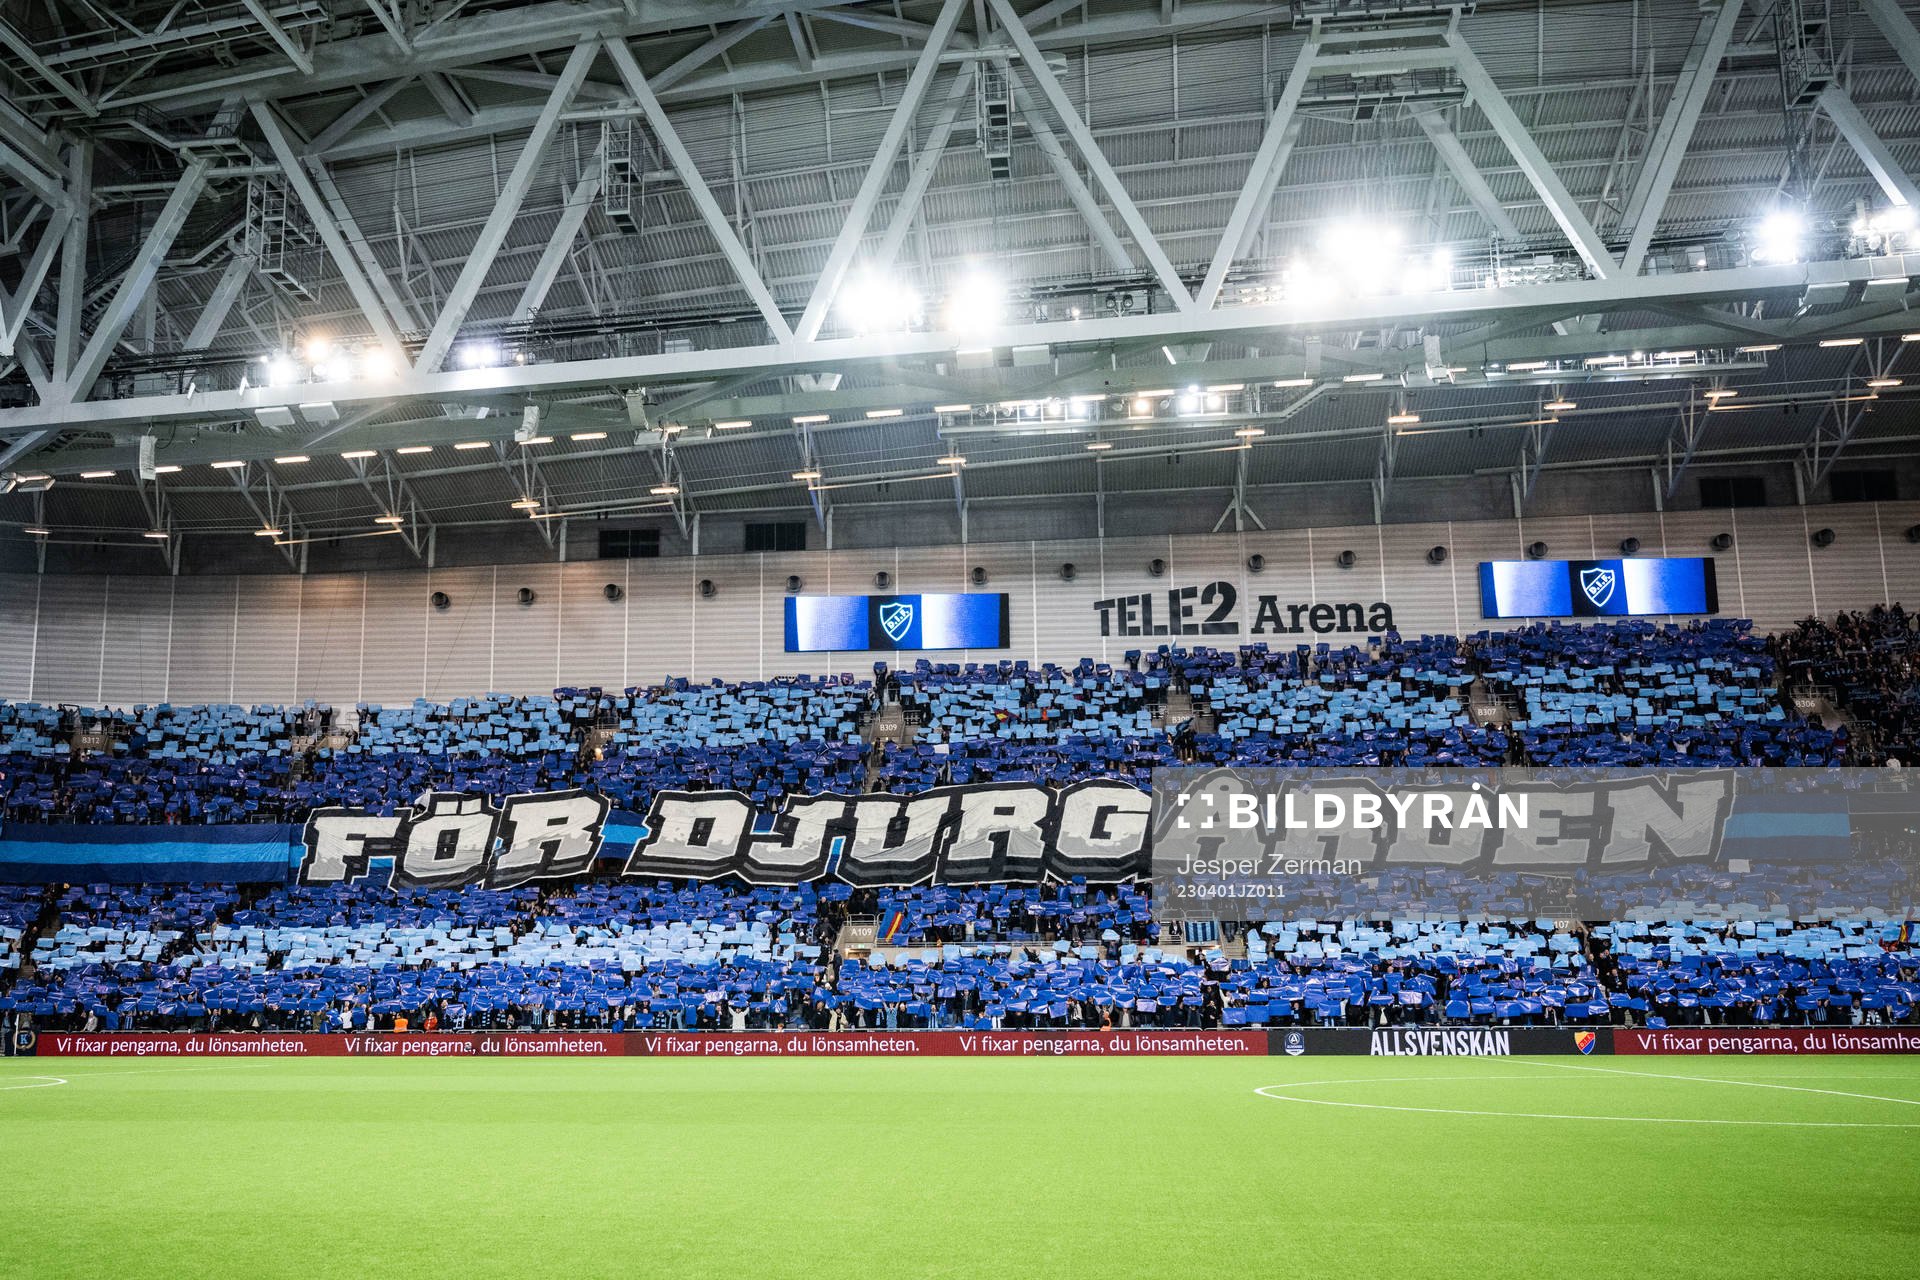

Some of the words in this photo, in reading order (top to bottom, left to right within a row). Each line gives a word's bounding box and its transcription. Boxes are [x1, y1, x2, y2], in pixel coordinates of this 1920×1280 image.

[1094, 581, 1239, 636] TELE2
[1250, 595, 1397, 634] Arena
[299, 791, 608, 886] FÖR
[851, 928, 872, 936] A109
[56, 1037, 72, 1052] Vi
[75, 1037, 107, 1052] fixar
[111, 1041, 182, 1055] pengarna,
[185, 1037, 205, 1052] du
[208, 1037, 308, 1053] lönsamheten.
[344, 1037, 361, 1052] Vi
[364, 1037, 398, 1052] fixar
[480, 1037, 500, 1052] du
[504, 1037, 608, 1053] lönsamheten.
[644, 1036, 662, 1052] Vi
[665, 1036, 702, 1052] fixar
[705, 1041, 783, 1055] pengarna,
[787, 1036, 807, 1052] du
[812, 1036, 920, 1052] lönsamheten.
[959, 1036, 977, 1052] Vi
[981, 1036, 1019, 1052] fixar
[1023, 1040, 1105, 1055] pengarna,
[1109, 1035, 1131, 1052] du
[1135, 1035, 1249, 1052] lönsamheten.
[1370, 1031, 1511, 1056] ALLSVENSKAN
[1637, 1034, 1657, 1050] Vi
[1661, 1034, 1703, 1050] fixar
[1707, 1038, 1798, 1054] pengarna,
[1803, 1033, 1827, 1050] du
